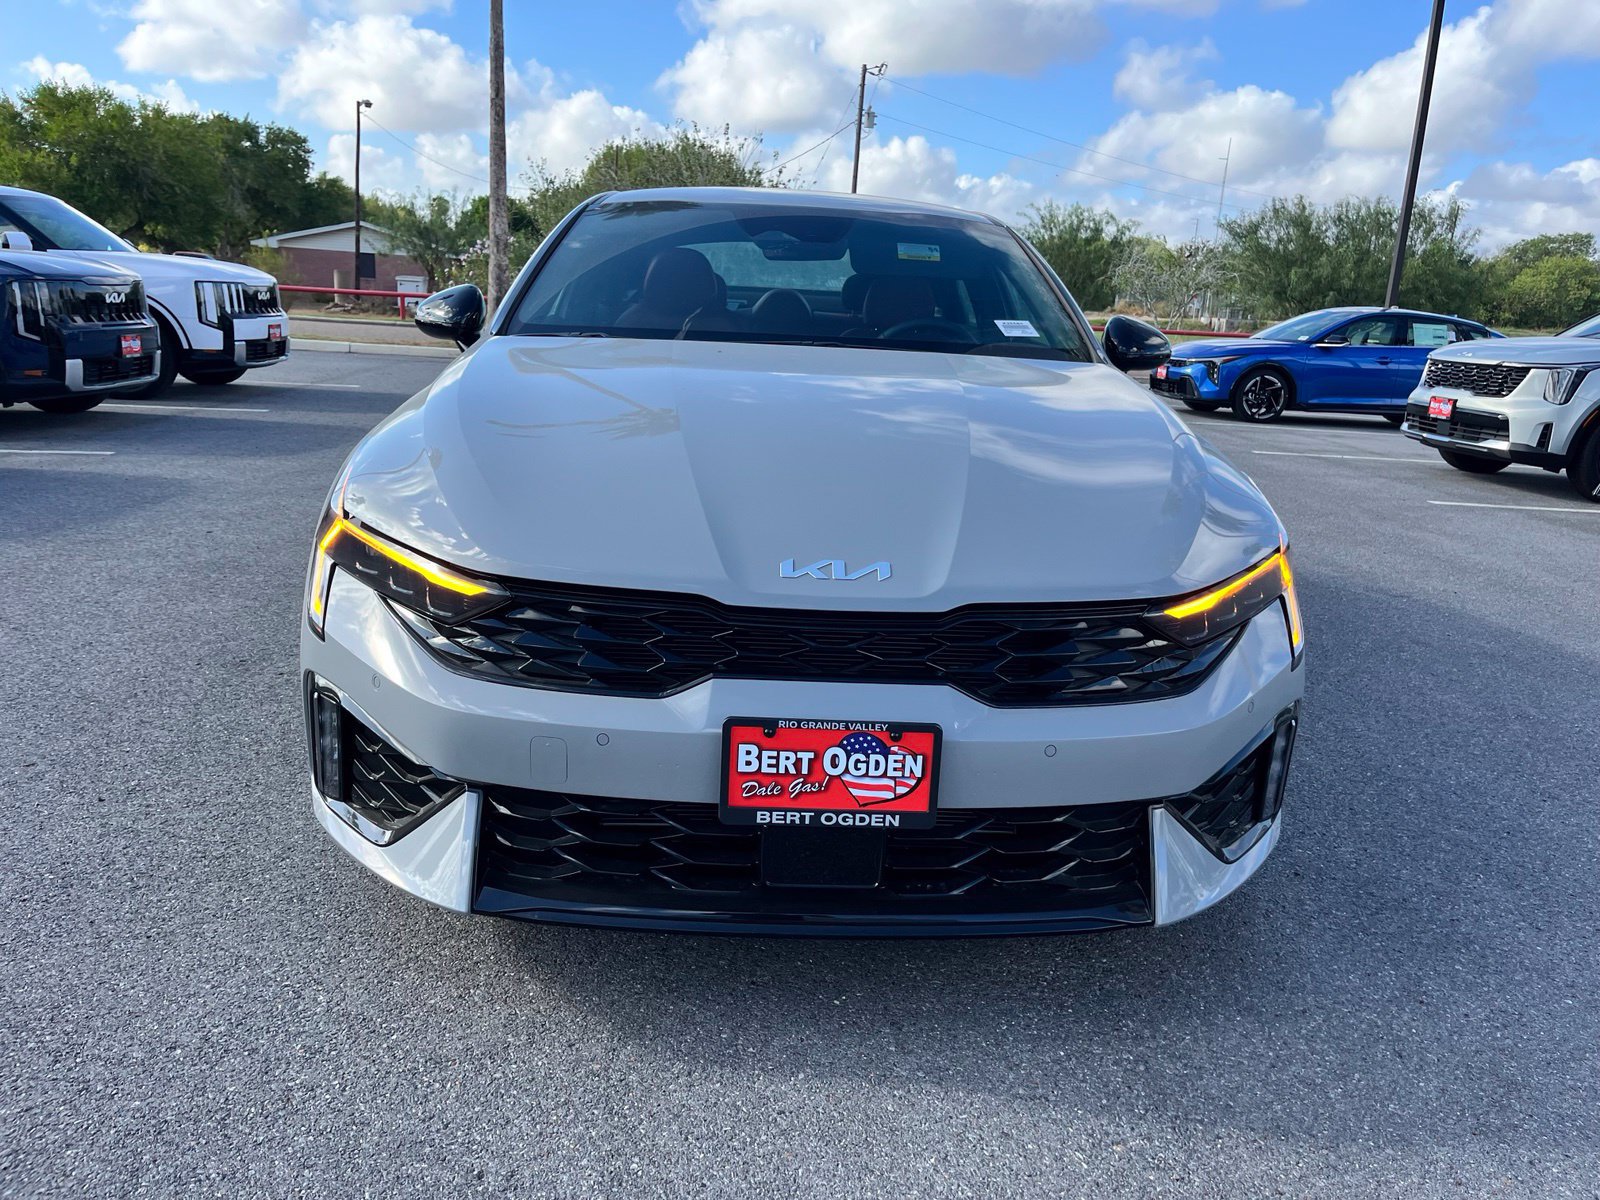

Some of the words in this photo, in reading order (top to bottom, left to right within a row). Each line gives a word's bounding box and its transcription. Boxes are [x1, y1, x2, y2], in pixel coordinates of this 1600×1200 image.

[780, 558, 892, 581] KIA
[778, 720, 798, 729] RIO
[800, 721, 846, 730] GRANDE
[848, 722, 889, 732] VALLEY
[737, 743, 815, 775] BERT
[822, 746, 924, 778] OGDEN
[741, 781, 782, 798] Dale
[788, 775, 830, 799] Gas!
[756, 810, 815, 825] BERT
[820, 812, 900, 827] OGDEN
